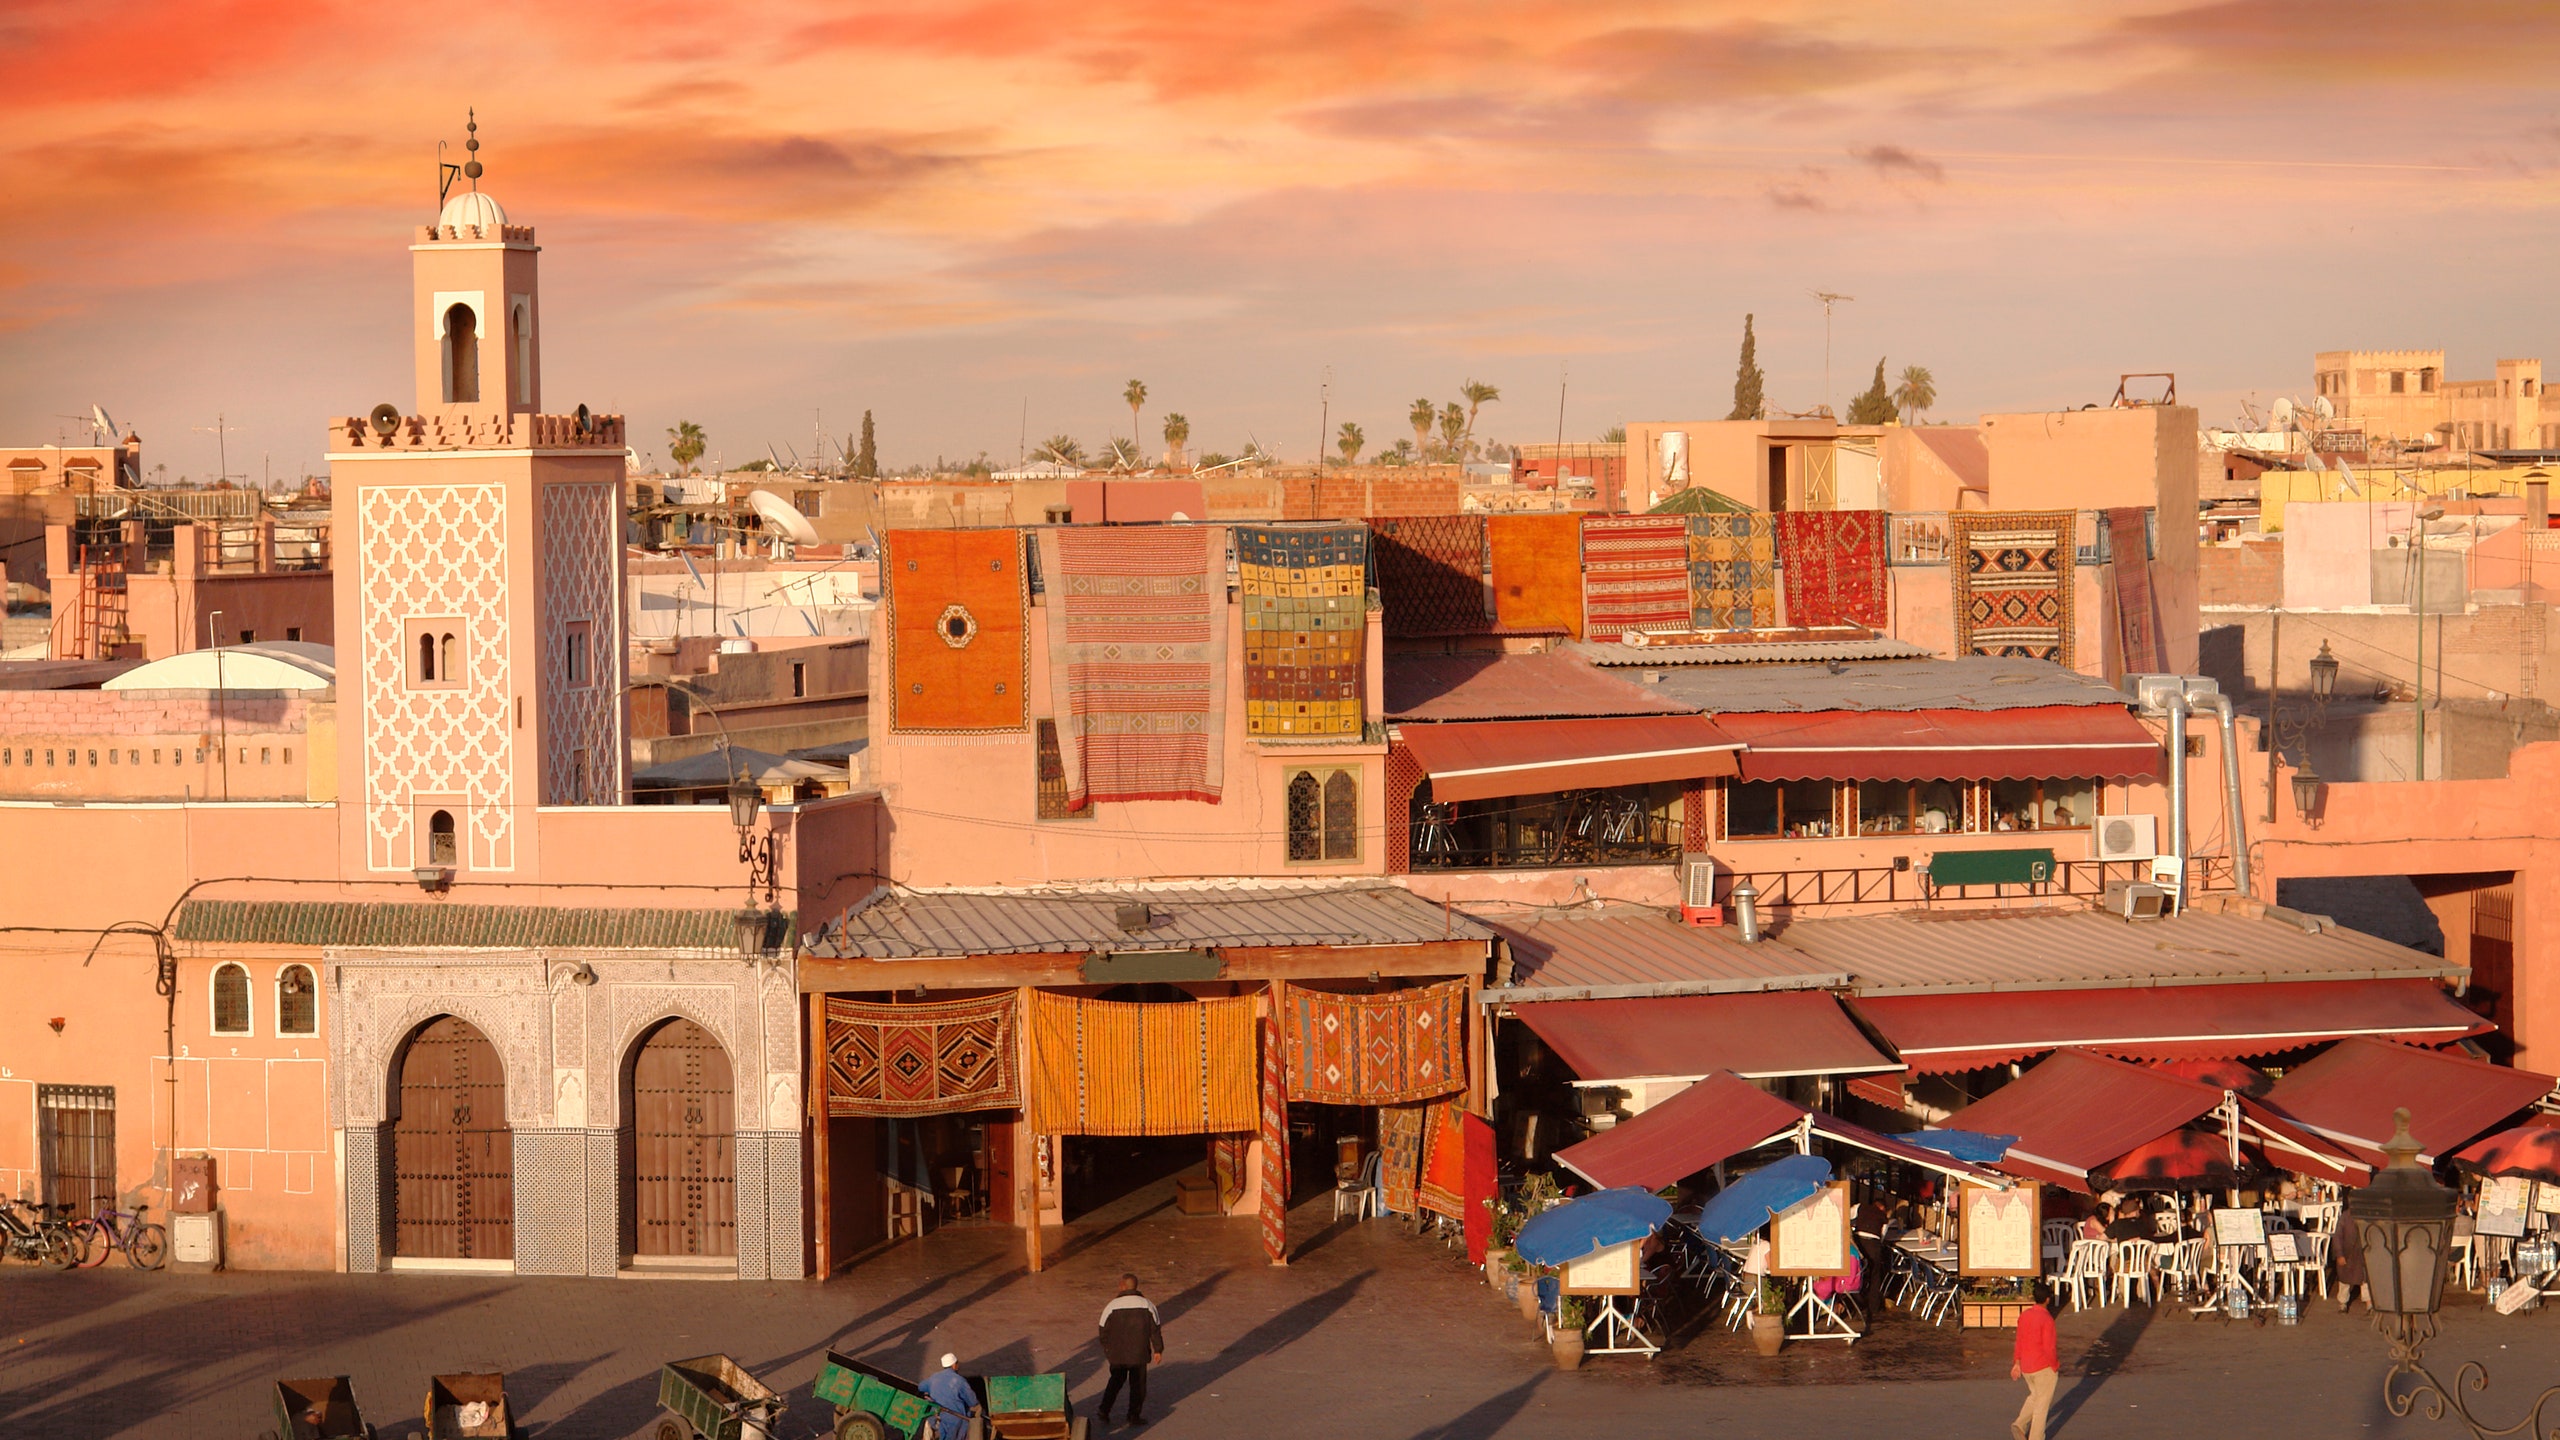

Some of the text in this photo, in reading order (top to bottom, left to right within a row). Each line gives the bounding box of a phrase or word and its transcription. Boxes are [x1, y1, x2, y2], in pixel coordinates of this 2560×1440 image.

[181, 1044, 189, 1057] 3
[292, 1047, 300, 1058] 1
[2, 1066, 14, 1078] 4
